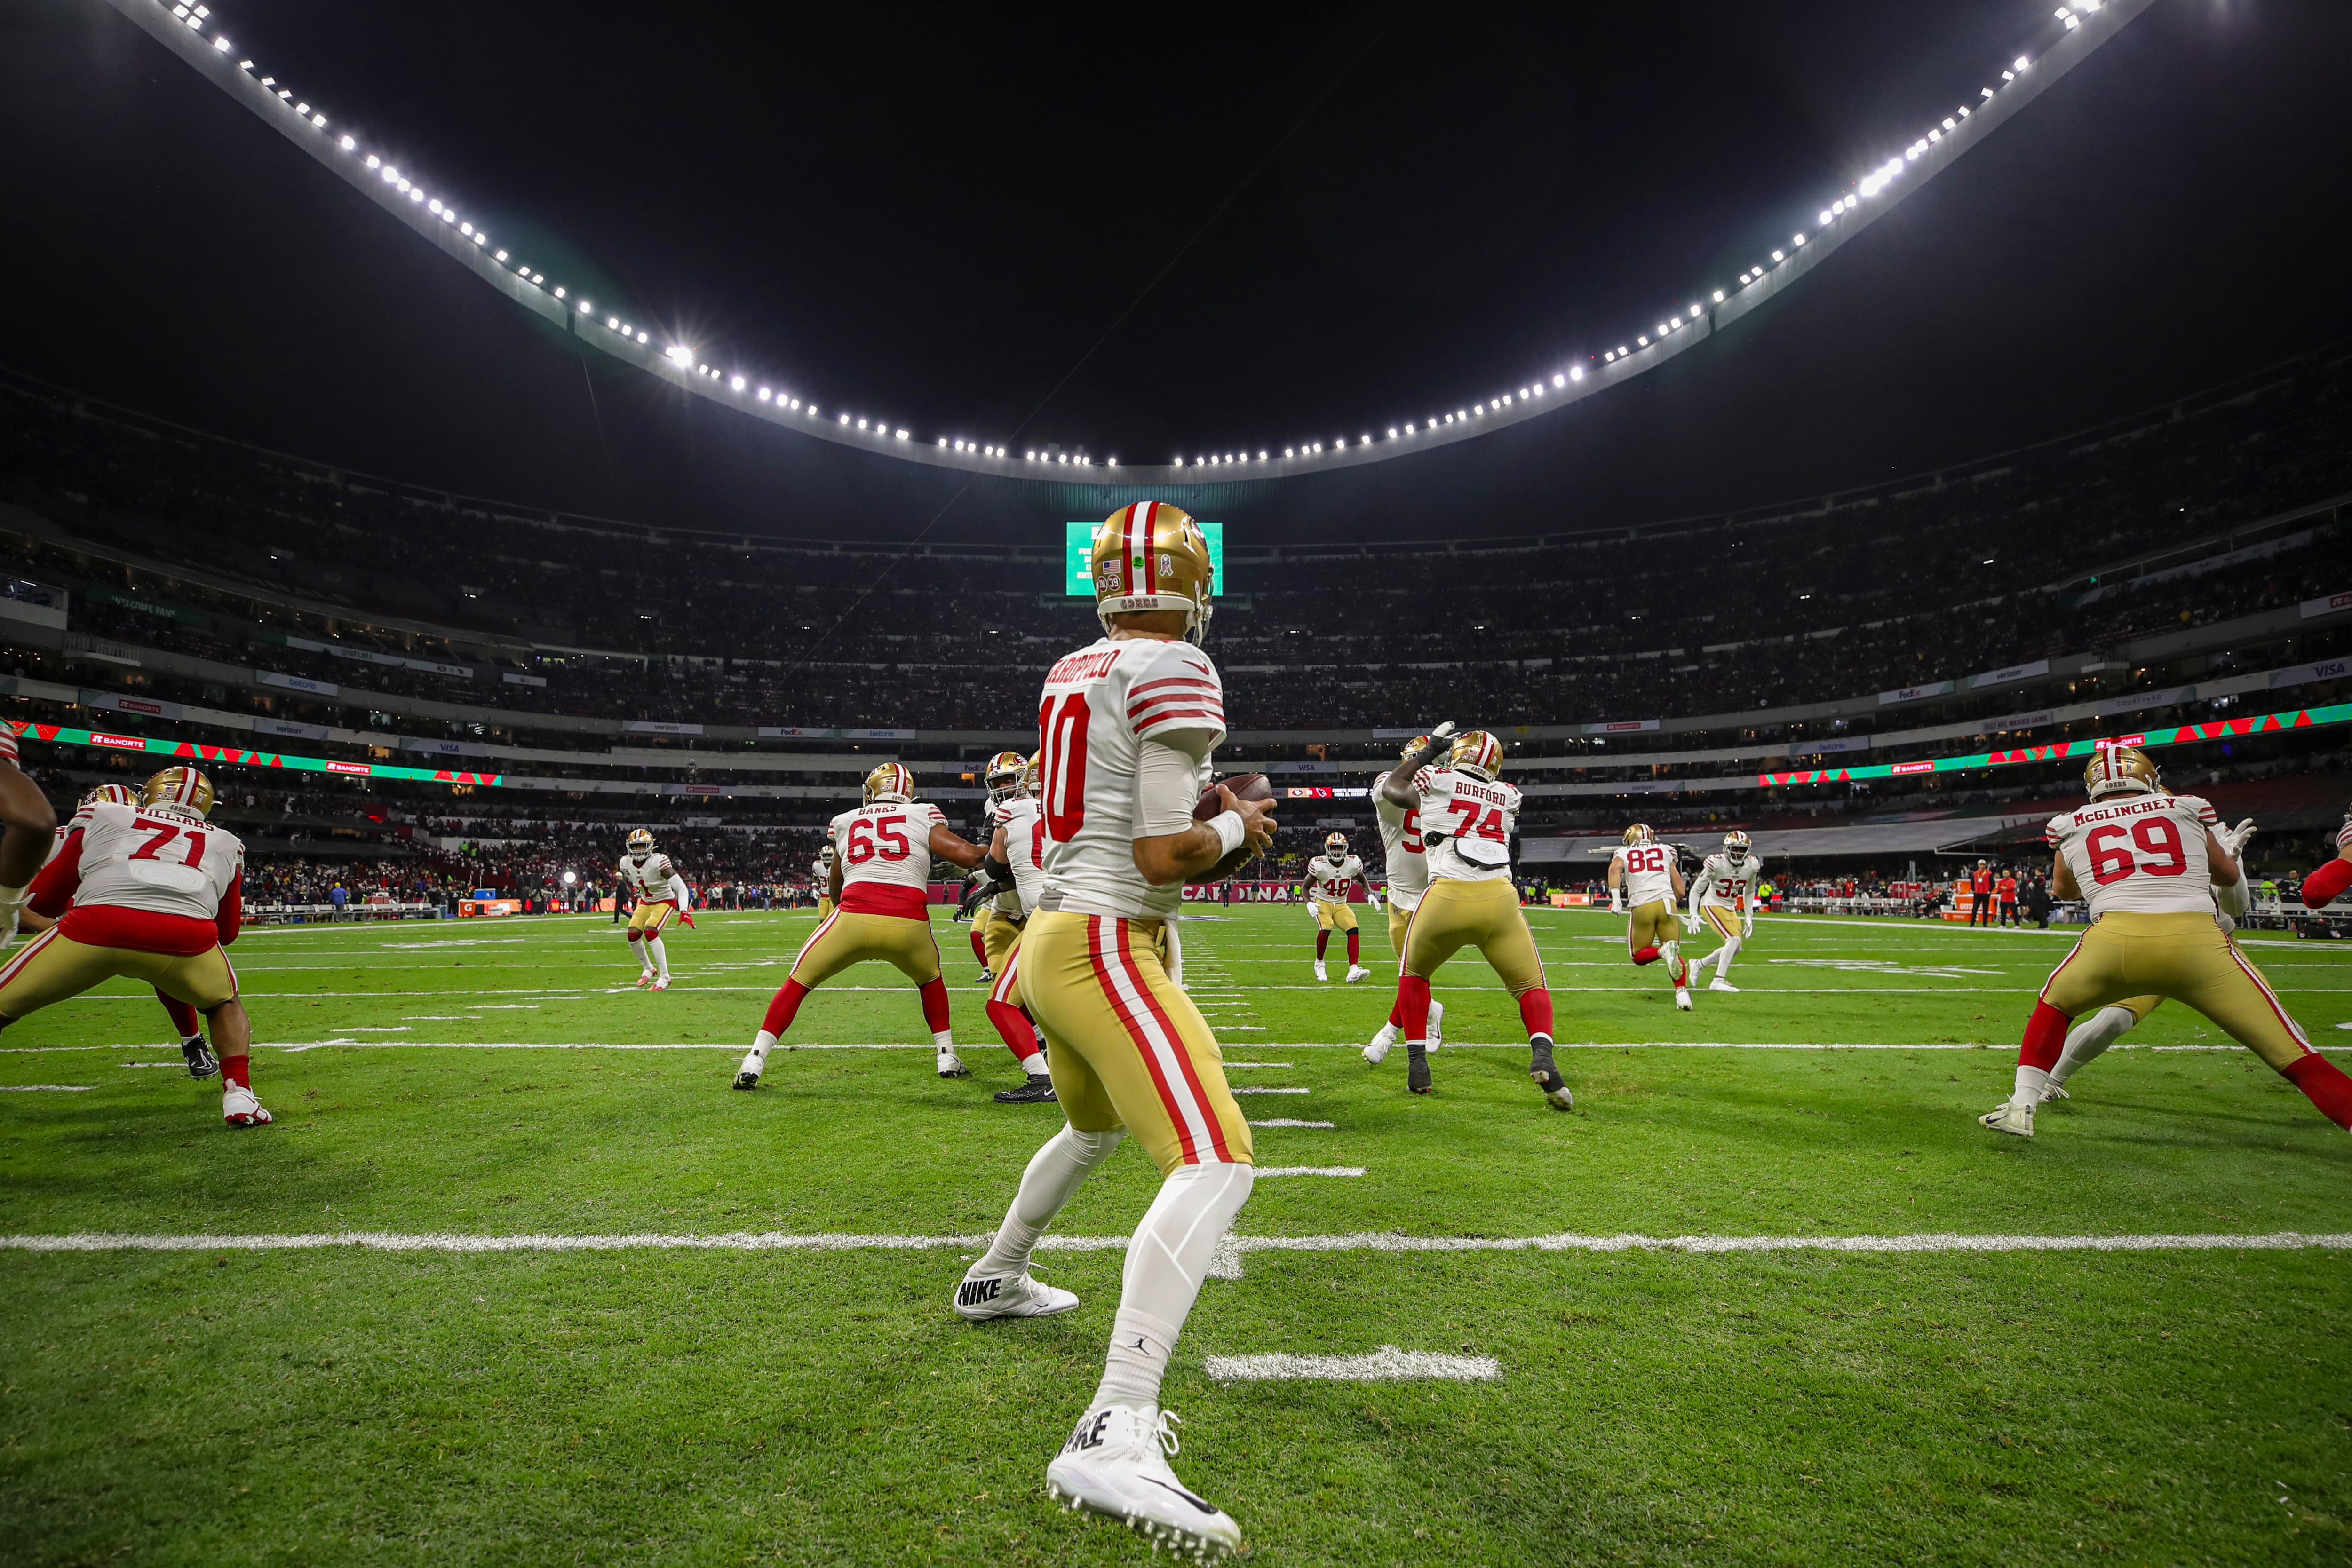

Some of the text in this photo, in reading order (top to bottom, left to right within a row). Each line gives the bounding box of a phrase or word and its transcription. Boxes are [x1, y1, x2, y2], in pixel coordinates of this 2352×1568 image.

[1109, 578, 1119, 587] 39
[1120, 598, 1159, 610] 49ERS
[1997, 670, 2021, 679] verizon
[2314, 663, 2345, 677] VISA
[1899, 689, 1920, 699] FedEx
[2117, 694, 2161, 706] COURTYARD
[129, 704, 159, 713] BANORTE
[104, 738, 144, 747] BANORTE
[440, 744, 459, 752] VISA
[2106, 737, 2142, 747] BORTE
[336, 765, 369, 774] BANORTE
[1039, 692, 1091, 843] 10
[1901, 763, 1932, 772] BANORTE
[1455, 781, 1506, 806] BURFORD
[858, 805, 898, 816] BANKS
[2073, 798, 2176, 827] McGLINCHEY
[135, 807, 215, 832] WILLIAMS
[1447, 799, 1505, 844] 74
[128, 817, 206, 872] 71
[847, 815, 910, 865] 65
[2085, 816, 2187, 886] 69
[1627, 848, 1665, 874] 82
[639, 879, 653, 897] 1
[1323, 878, 1351, 897] 48
[958, 1278, 1002, 1306] NIKE
